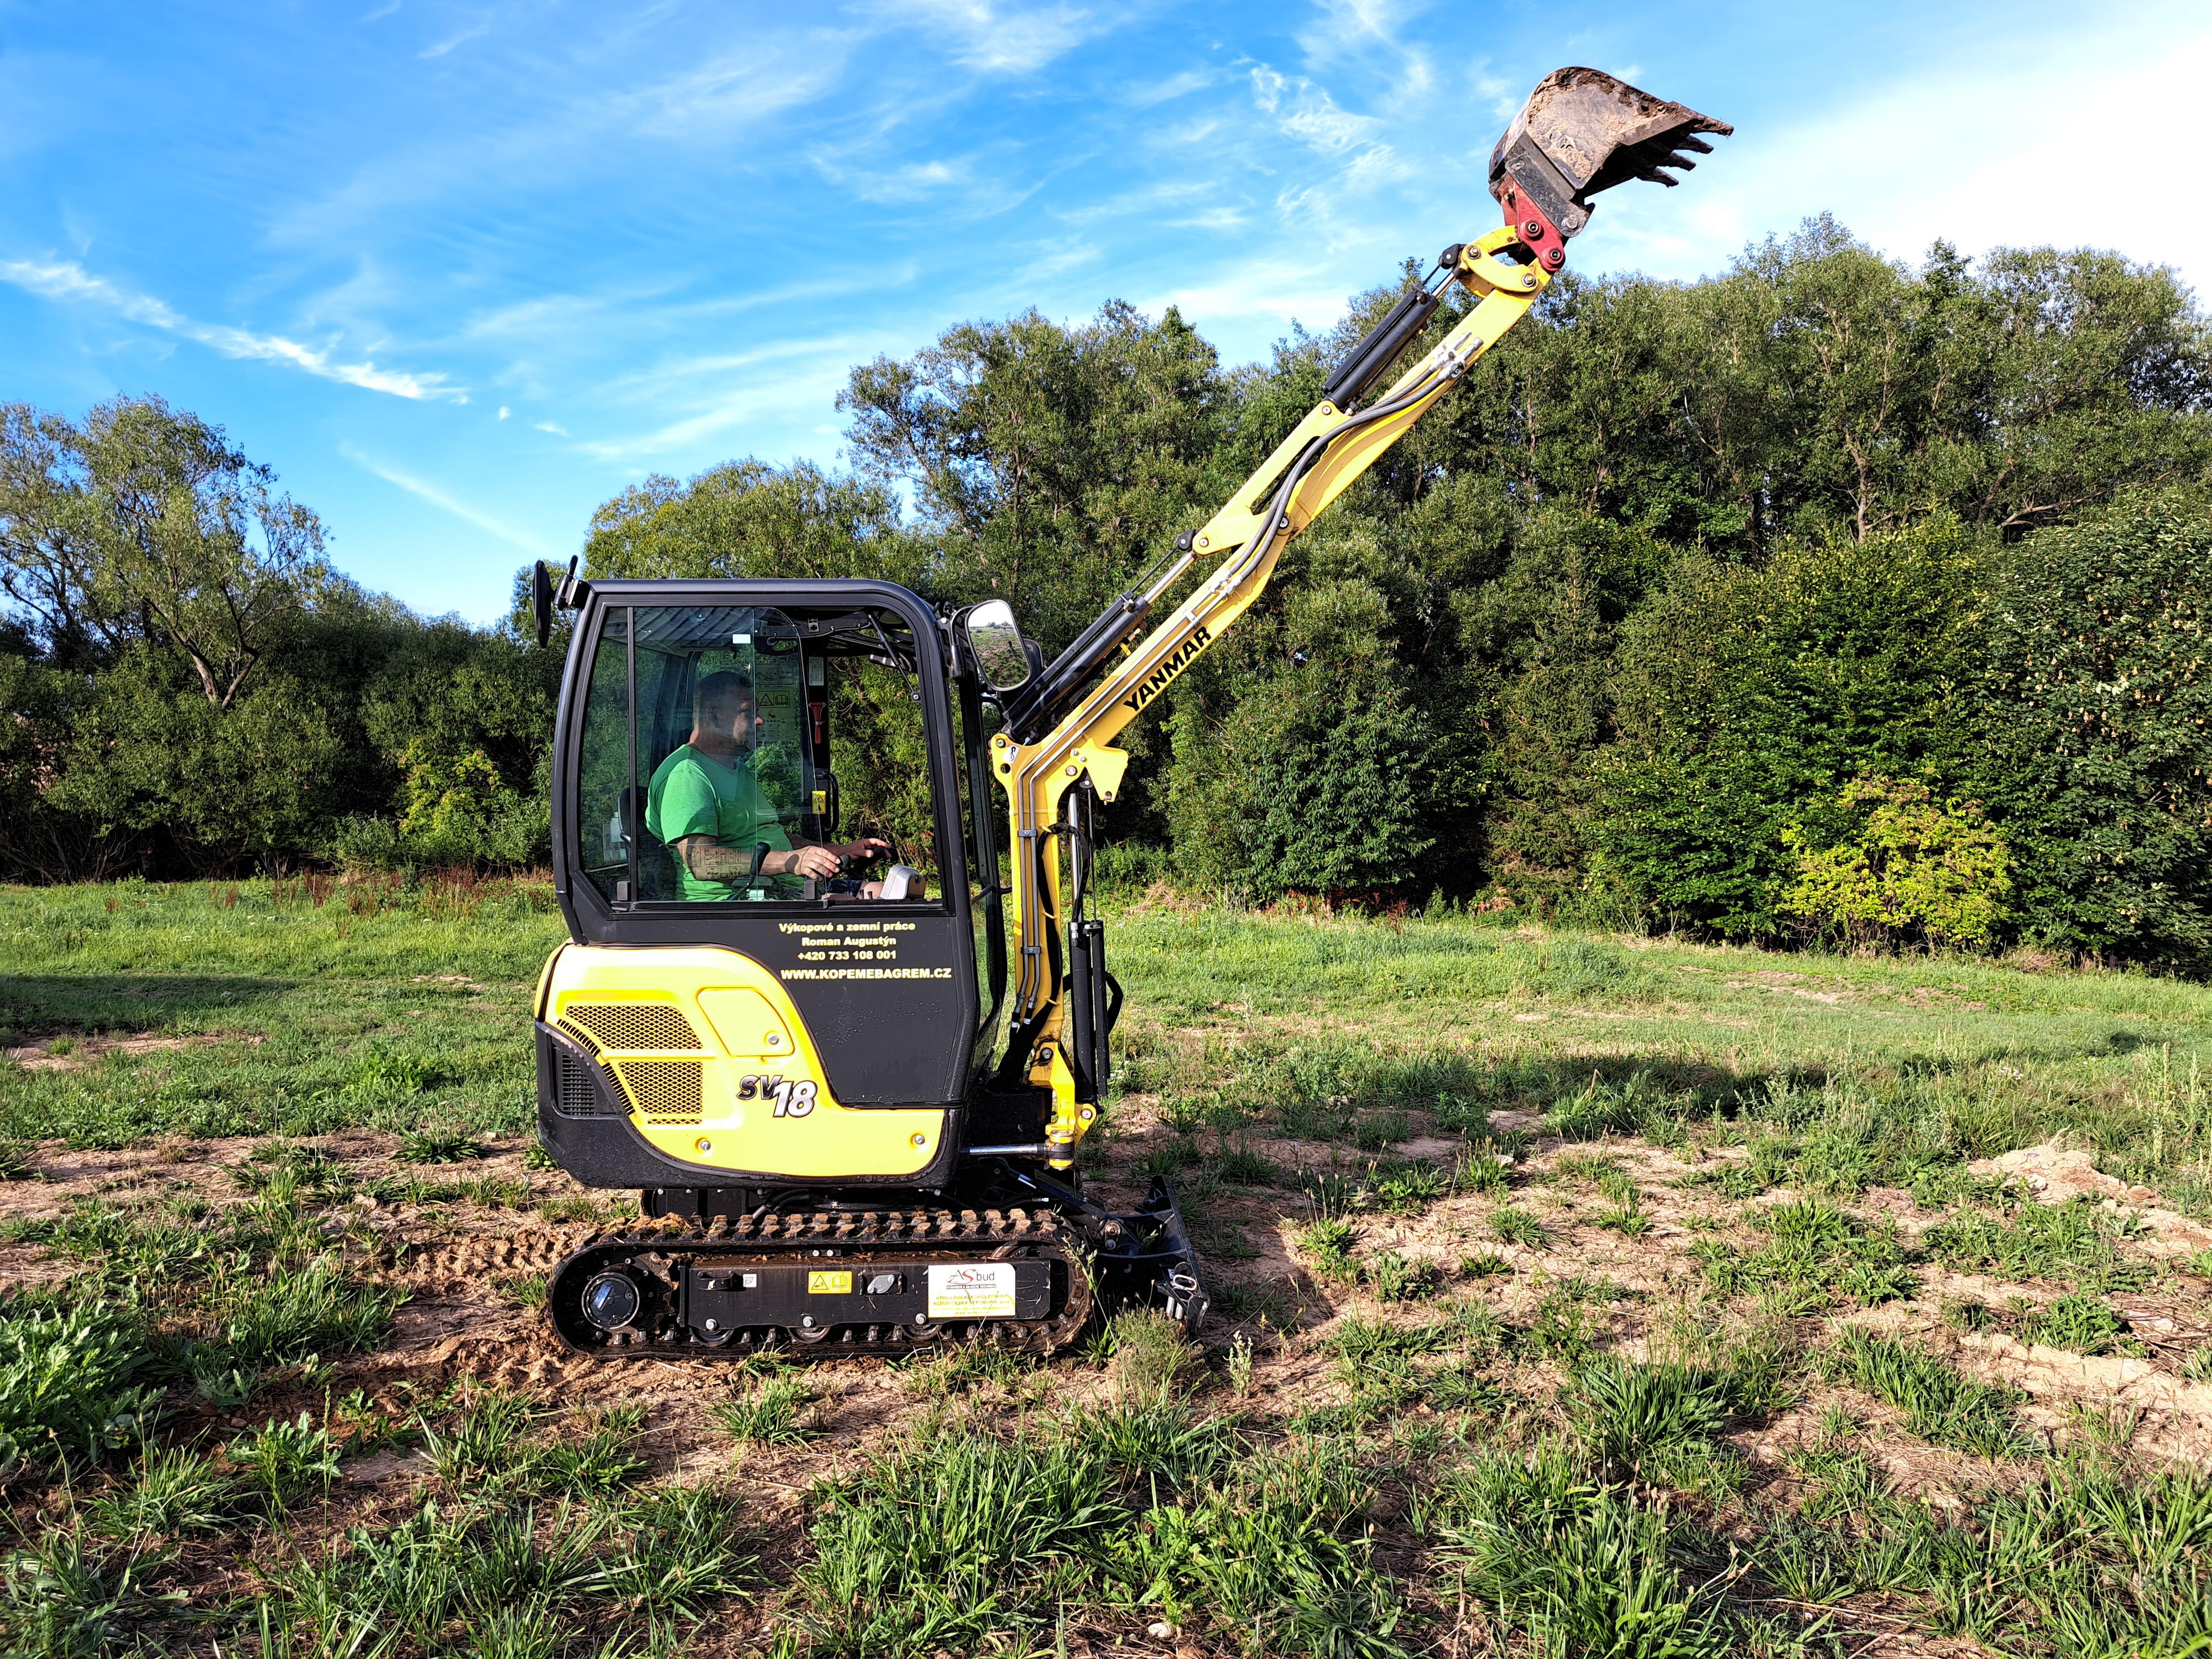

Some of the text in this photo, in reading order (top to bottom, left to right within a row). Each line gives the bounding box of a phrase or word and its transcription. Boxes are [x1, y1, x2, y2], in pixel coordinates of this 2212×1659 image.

[1123, 626, 1212, 712] YANMAR
[779, 922, 833, 935] Výkopové
[846, 921, 880, 931] zemní
[883, 921, 916, 932] práce
[802, 936, 896, 947] Roman Augustýn
[797, 950, 896, 961] +420 733 108 001
[780, 968, 952, 980] WWW.KOPEMEBAGREM.CZ
